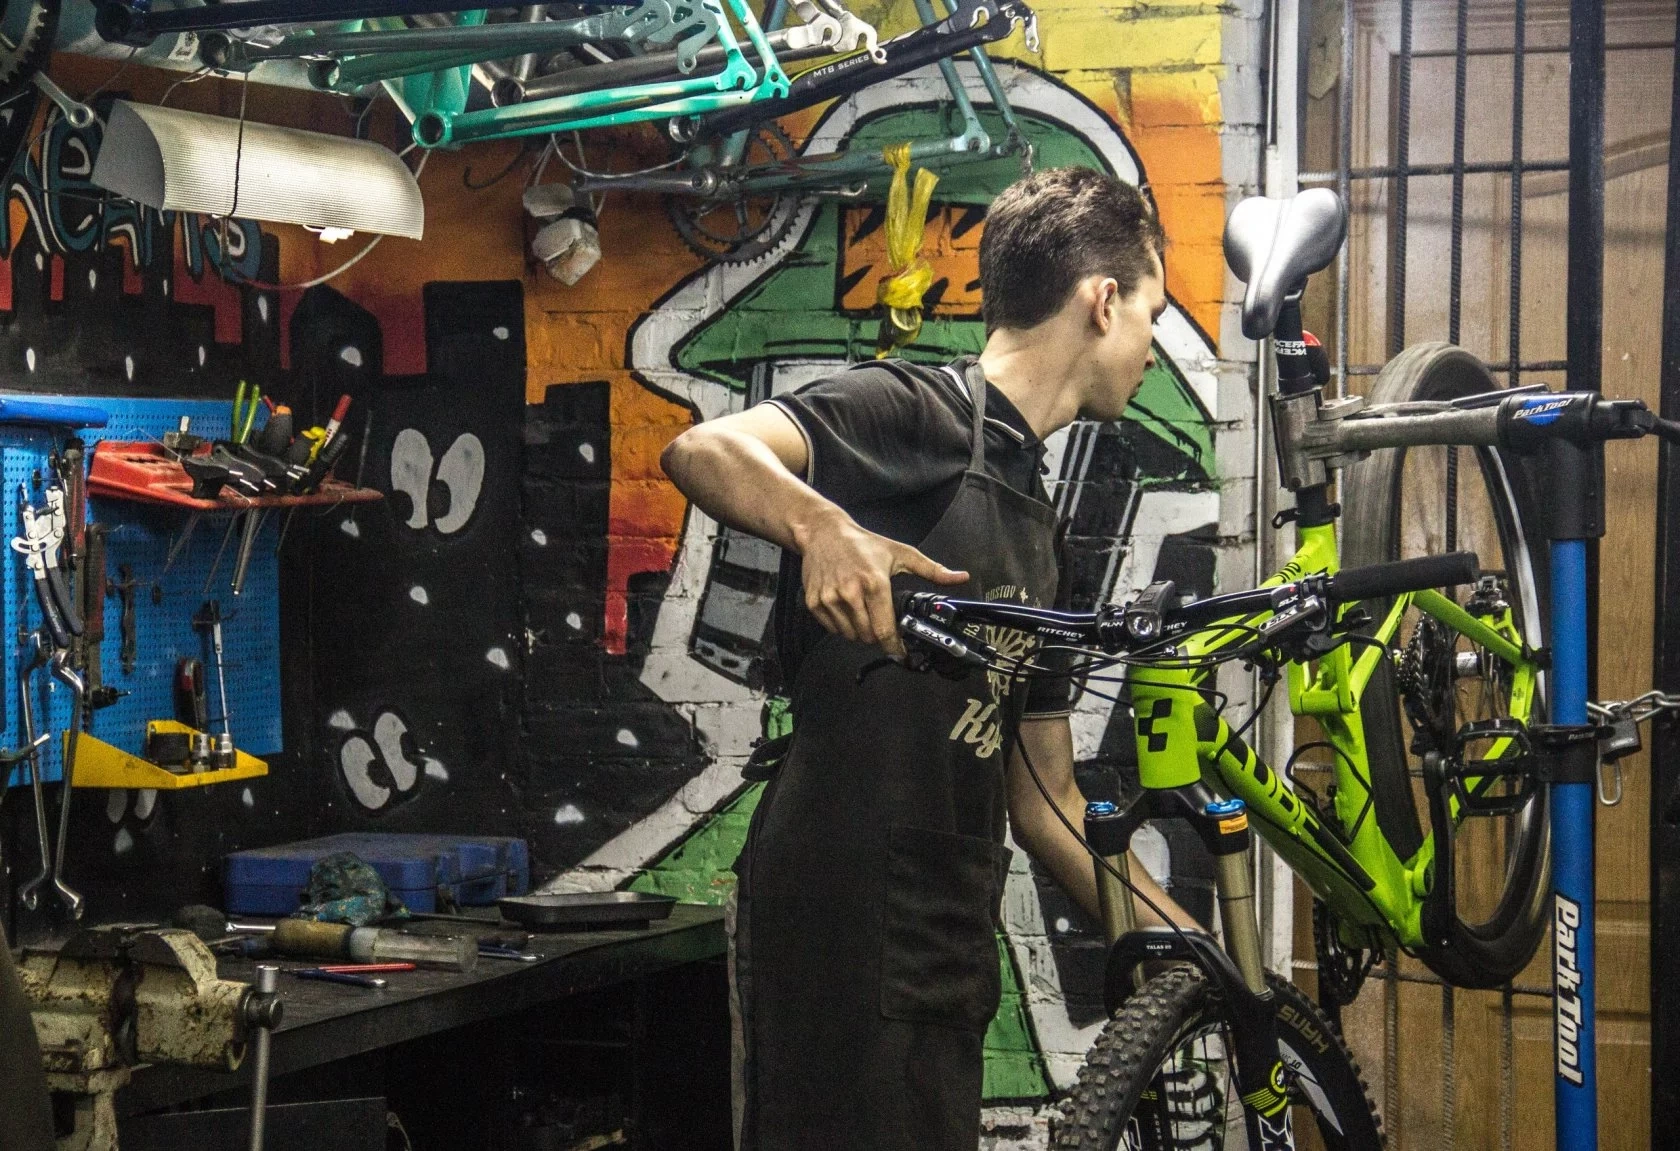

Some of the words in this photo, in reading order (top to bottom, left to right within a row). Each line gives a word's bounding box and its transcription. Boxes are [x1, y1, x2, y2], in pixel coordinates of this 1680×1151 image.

[813, 65, 835, 78] MTB
[837, 54, 869, 70] SERIES
[929, 613, 948, 625] SLX
[1037, 626, 1085, 639] RITCHEY
